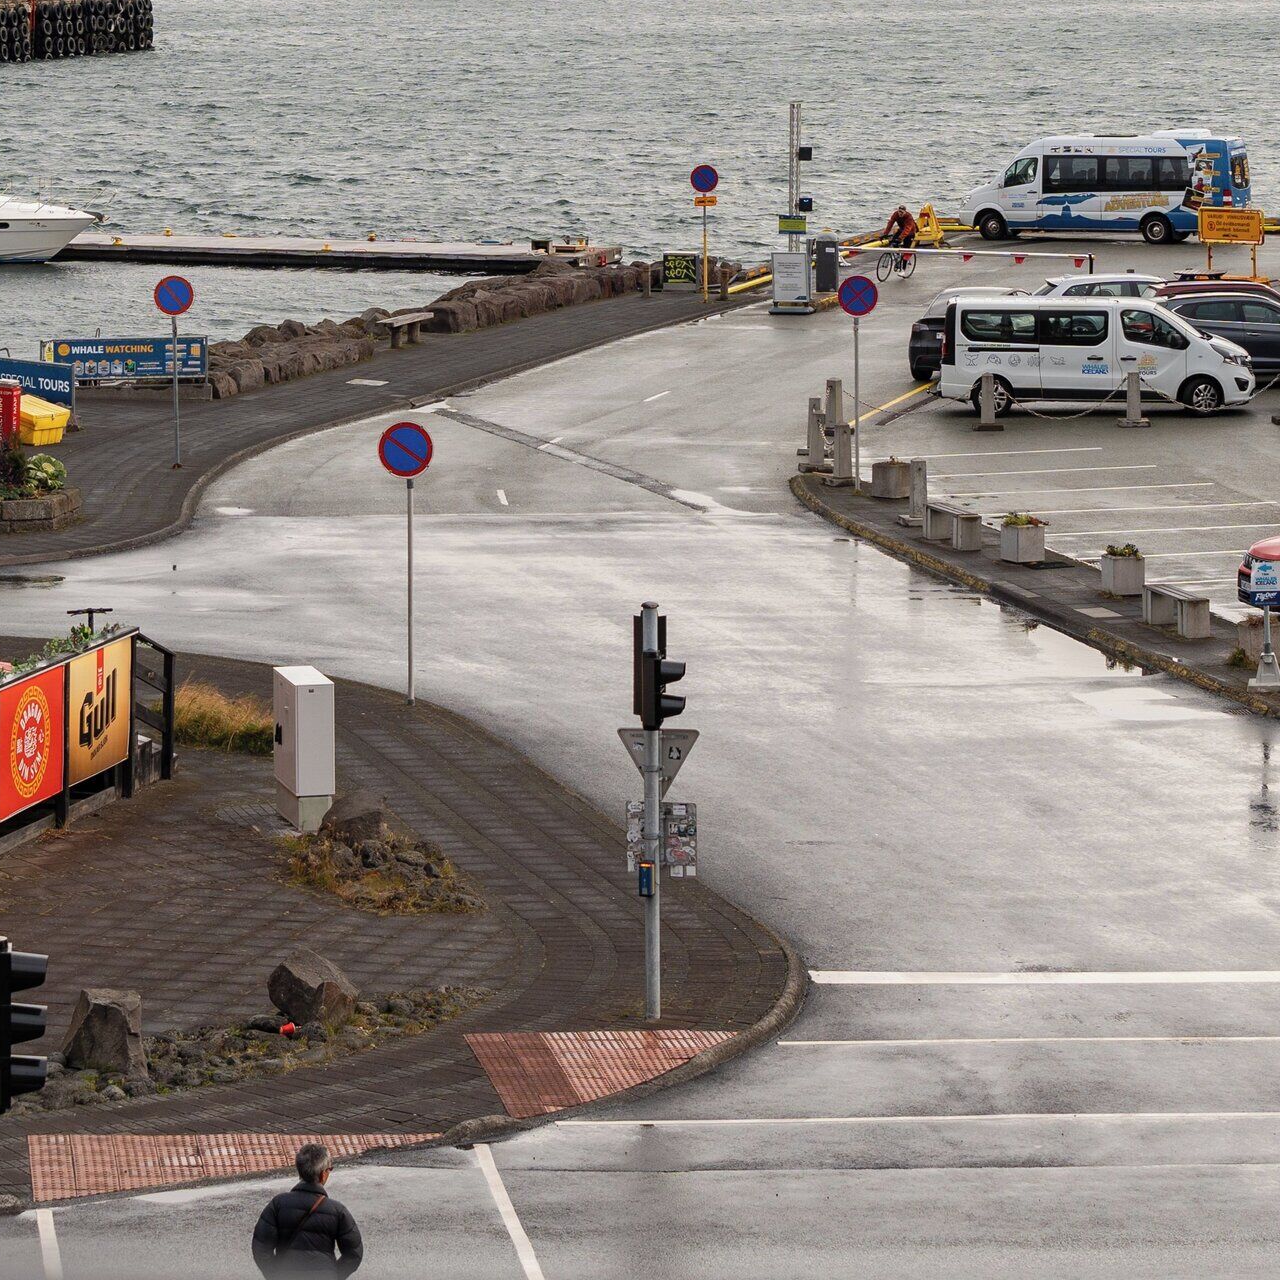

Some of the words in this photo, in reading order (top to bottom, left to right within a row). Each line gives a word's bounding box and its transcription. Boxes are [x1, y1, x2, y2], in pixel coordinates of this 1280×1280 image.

[71, 346, 104, 354] WHALE
[106, 345, 154, 353] WATCHING
[38, 378, 70, 393] TOURS
[20, 703, 42, 730] DRAGON
[79, 668, 116, 749] Gull
[18, 759, 29, 781] DIM
[30, 752, 43, 779] SUM
